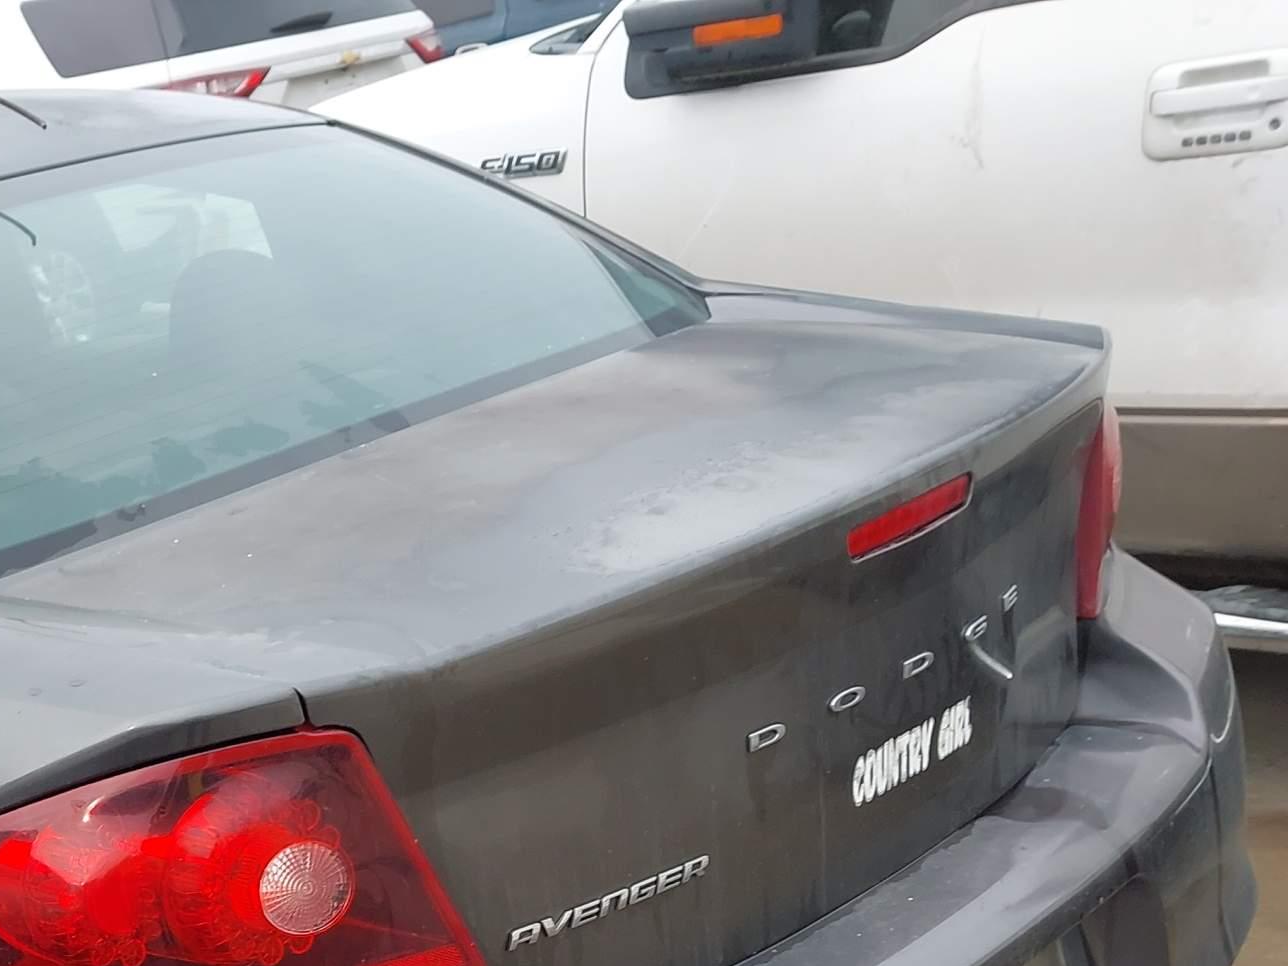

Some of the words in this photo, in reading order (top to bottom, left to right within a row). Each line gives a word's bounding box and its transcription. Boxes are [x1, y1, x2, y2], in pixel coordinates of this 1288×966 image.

[747, 584, 1018, 752] DODGE
[852, 716, 935, 807] COUNTRY
[505, 854, 710, 951] AVENGER
